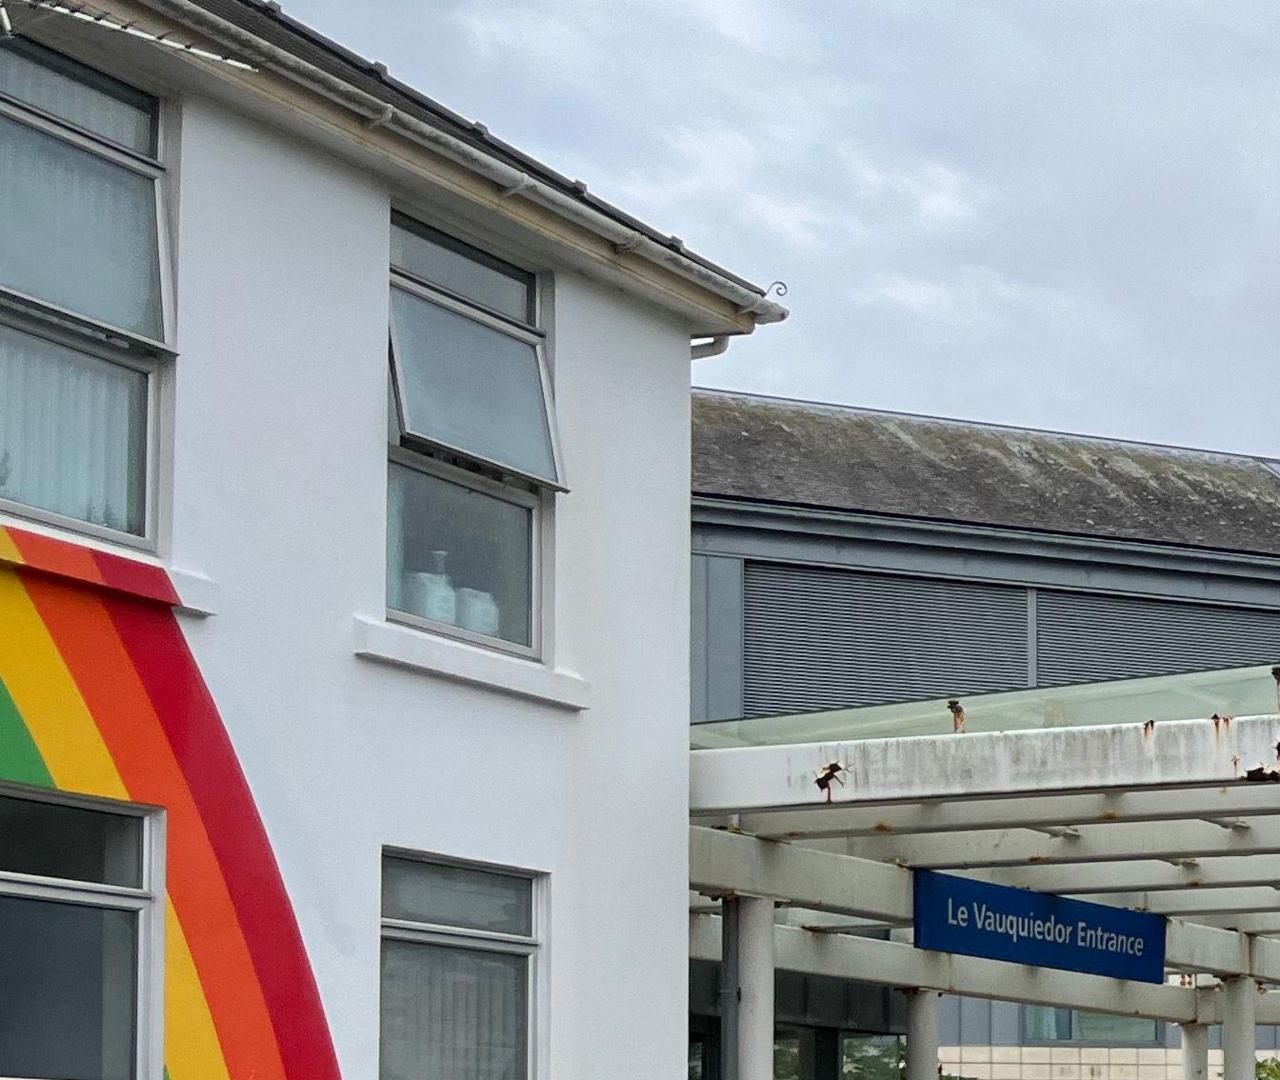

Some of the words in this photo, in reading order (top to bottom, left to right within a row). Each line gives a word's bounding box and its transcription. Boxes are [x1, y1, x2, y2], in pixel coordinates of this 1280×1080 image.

[948, 897, 968, 927] Le
[973, 902, 1072, 945] Vauquiedor
[1077, 921, 1144, 956] Entrance
